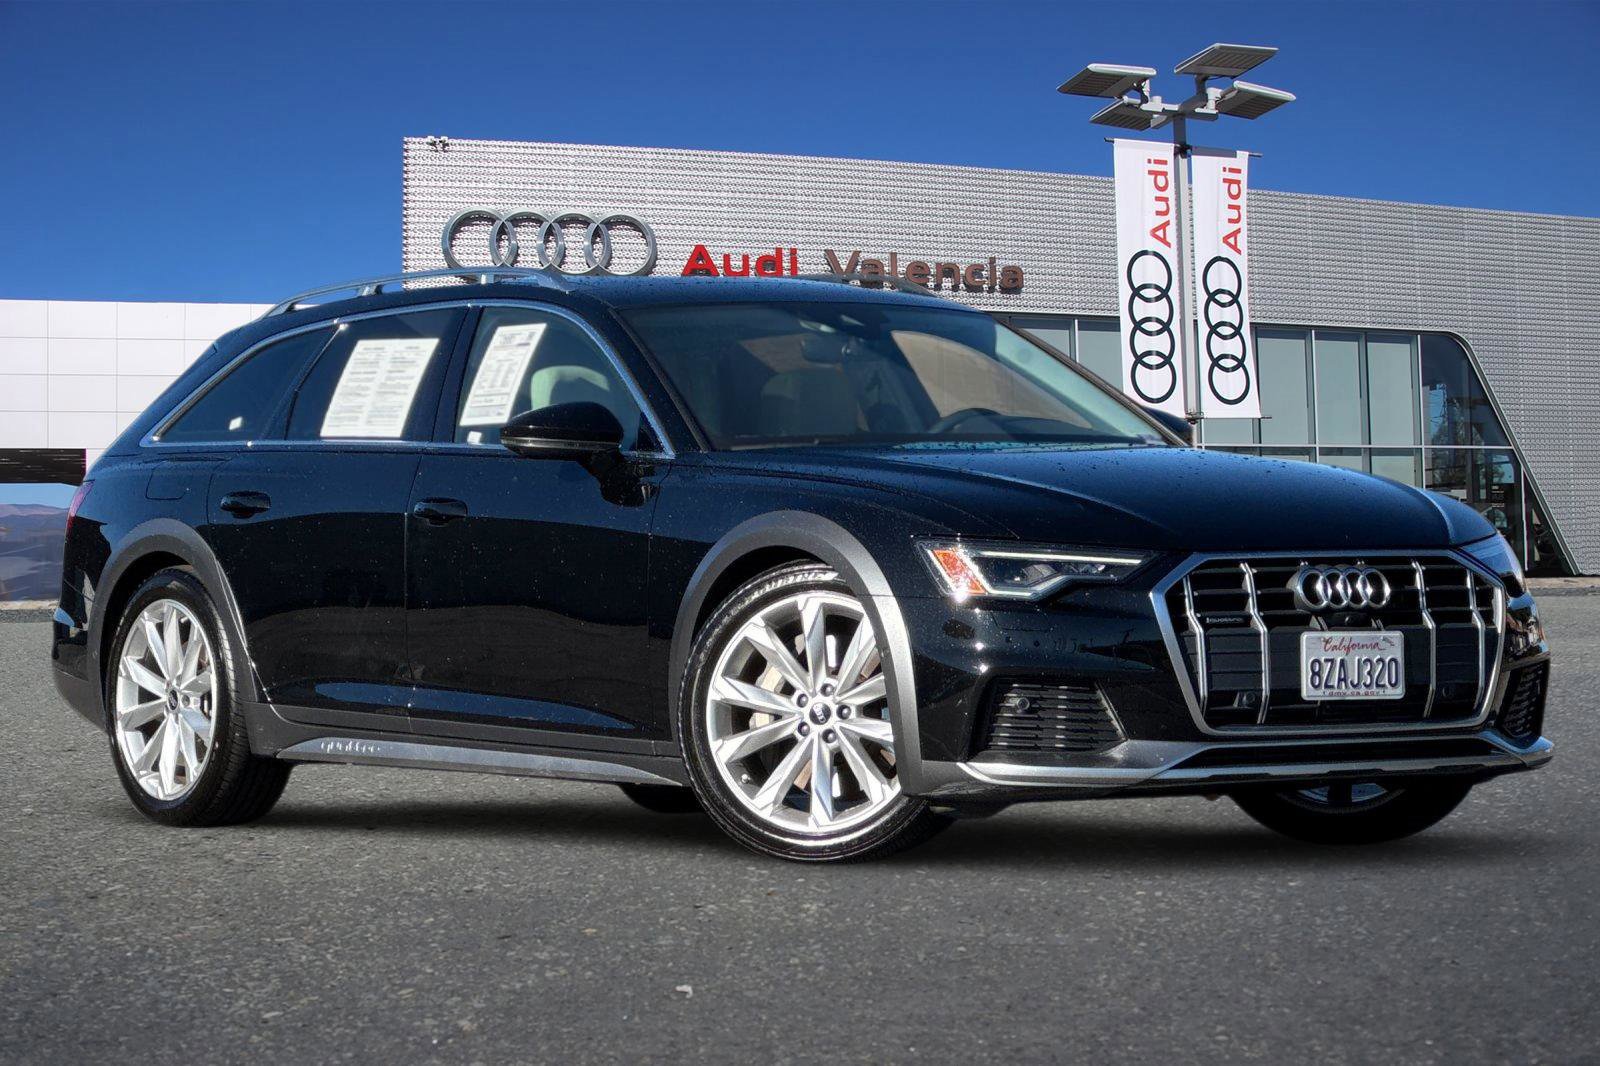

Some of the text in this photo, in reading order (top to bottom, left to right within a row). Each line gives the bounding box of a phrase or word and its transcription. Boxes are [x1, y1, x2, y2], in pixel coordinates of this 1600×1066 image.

[1148, 158, 1171, 248] Audi
[1222, 166, 1242, 255] Audi
[681, 244, 1024, 289] Audi Valencia
[1323, 637, 1386, 655] California
[1310, 658, 1399, 689] 8ZAJ320
